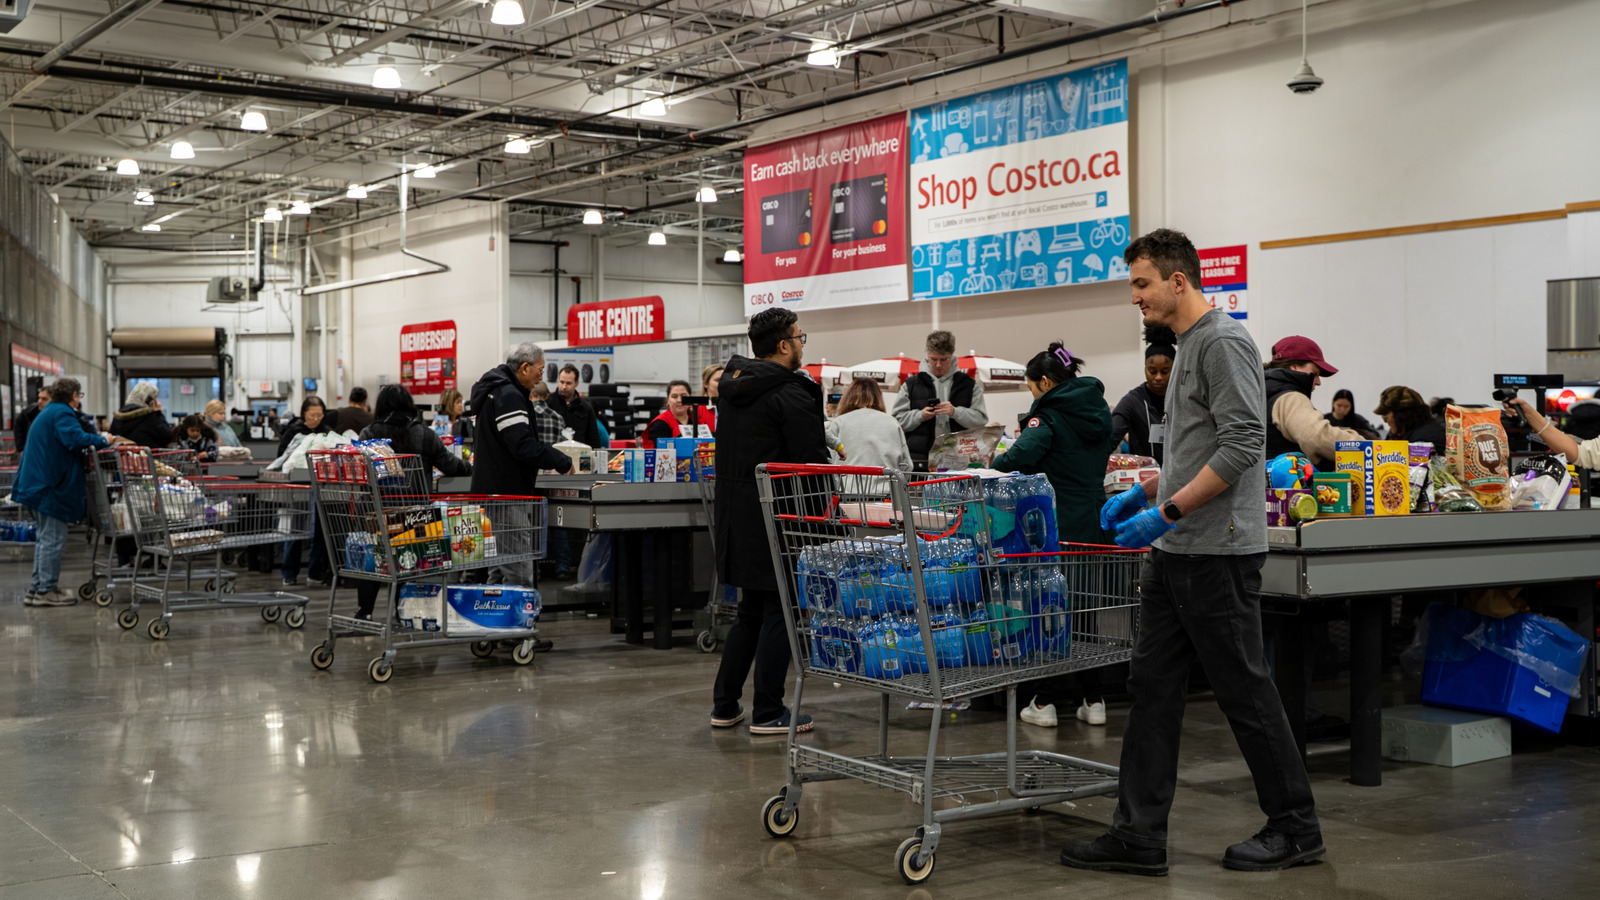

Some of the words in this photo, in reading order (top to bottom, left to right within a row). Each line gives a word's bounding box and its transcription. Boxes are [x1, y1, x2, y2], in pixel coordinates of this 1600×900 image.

[751, 163, 774, 182] Earn
[776, 154, 801, 177] cash
[802, 149, 829, 171] back
[830, 137, 899, 165] everywhere
[918, 174, 978, 210] Shop
[987, 150, 1121, 197] Costco.ca
[1042, 204, 1059, 213] Costco
[832, 247, 843, 259] For
[843, 246, 857, 259] your
[858, 243, 886, 256] business
[775, 256, 785, 267] For
[785, 255, 797, 267] you
[1221, 255, 1241, 266] PRICE
[1204, 266, 1236, 278] GASOLINE
[751, 293, 767, 305] CIBC
[577, 309, 604, 339] TIRE
[606, 304, 654, 338] CENTRE
[401, 328, 456, 353] MEMBERSHIP
[991, 369, 1024, 377] KIRKLAND
[1477, 440, 1497, 453] QUE
[1376, 451, 1407, 466] Shreddies
[1481, 451, 1499, 462] PASA
[1336, 461, 1363, 472] Shreddies
[1365, 446, 1374, 503] JUMBO
[405, 510, 433, 526] McCafé
[461, 517, 475, 527] All-
[453, 526, 478, 535] Bran
[474, 600, 490, 610] Bath
[491, 600, 511, 610] Tissue
